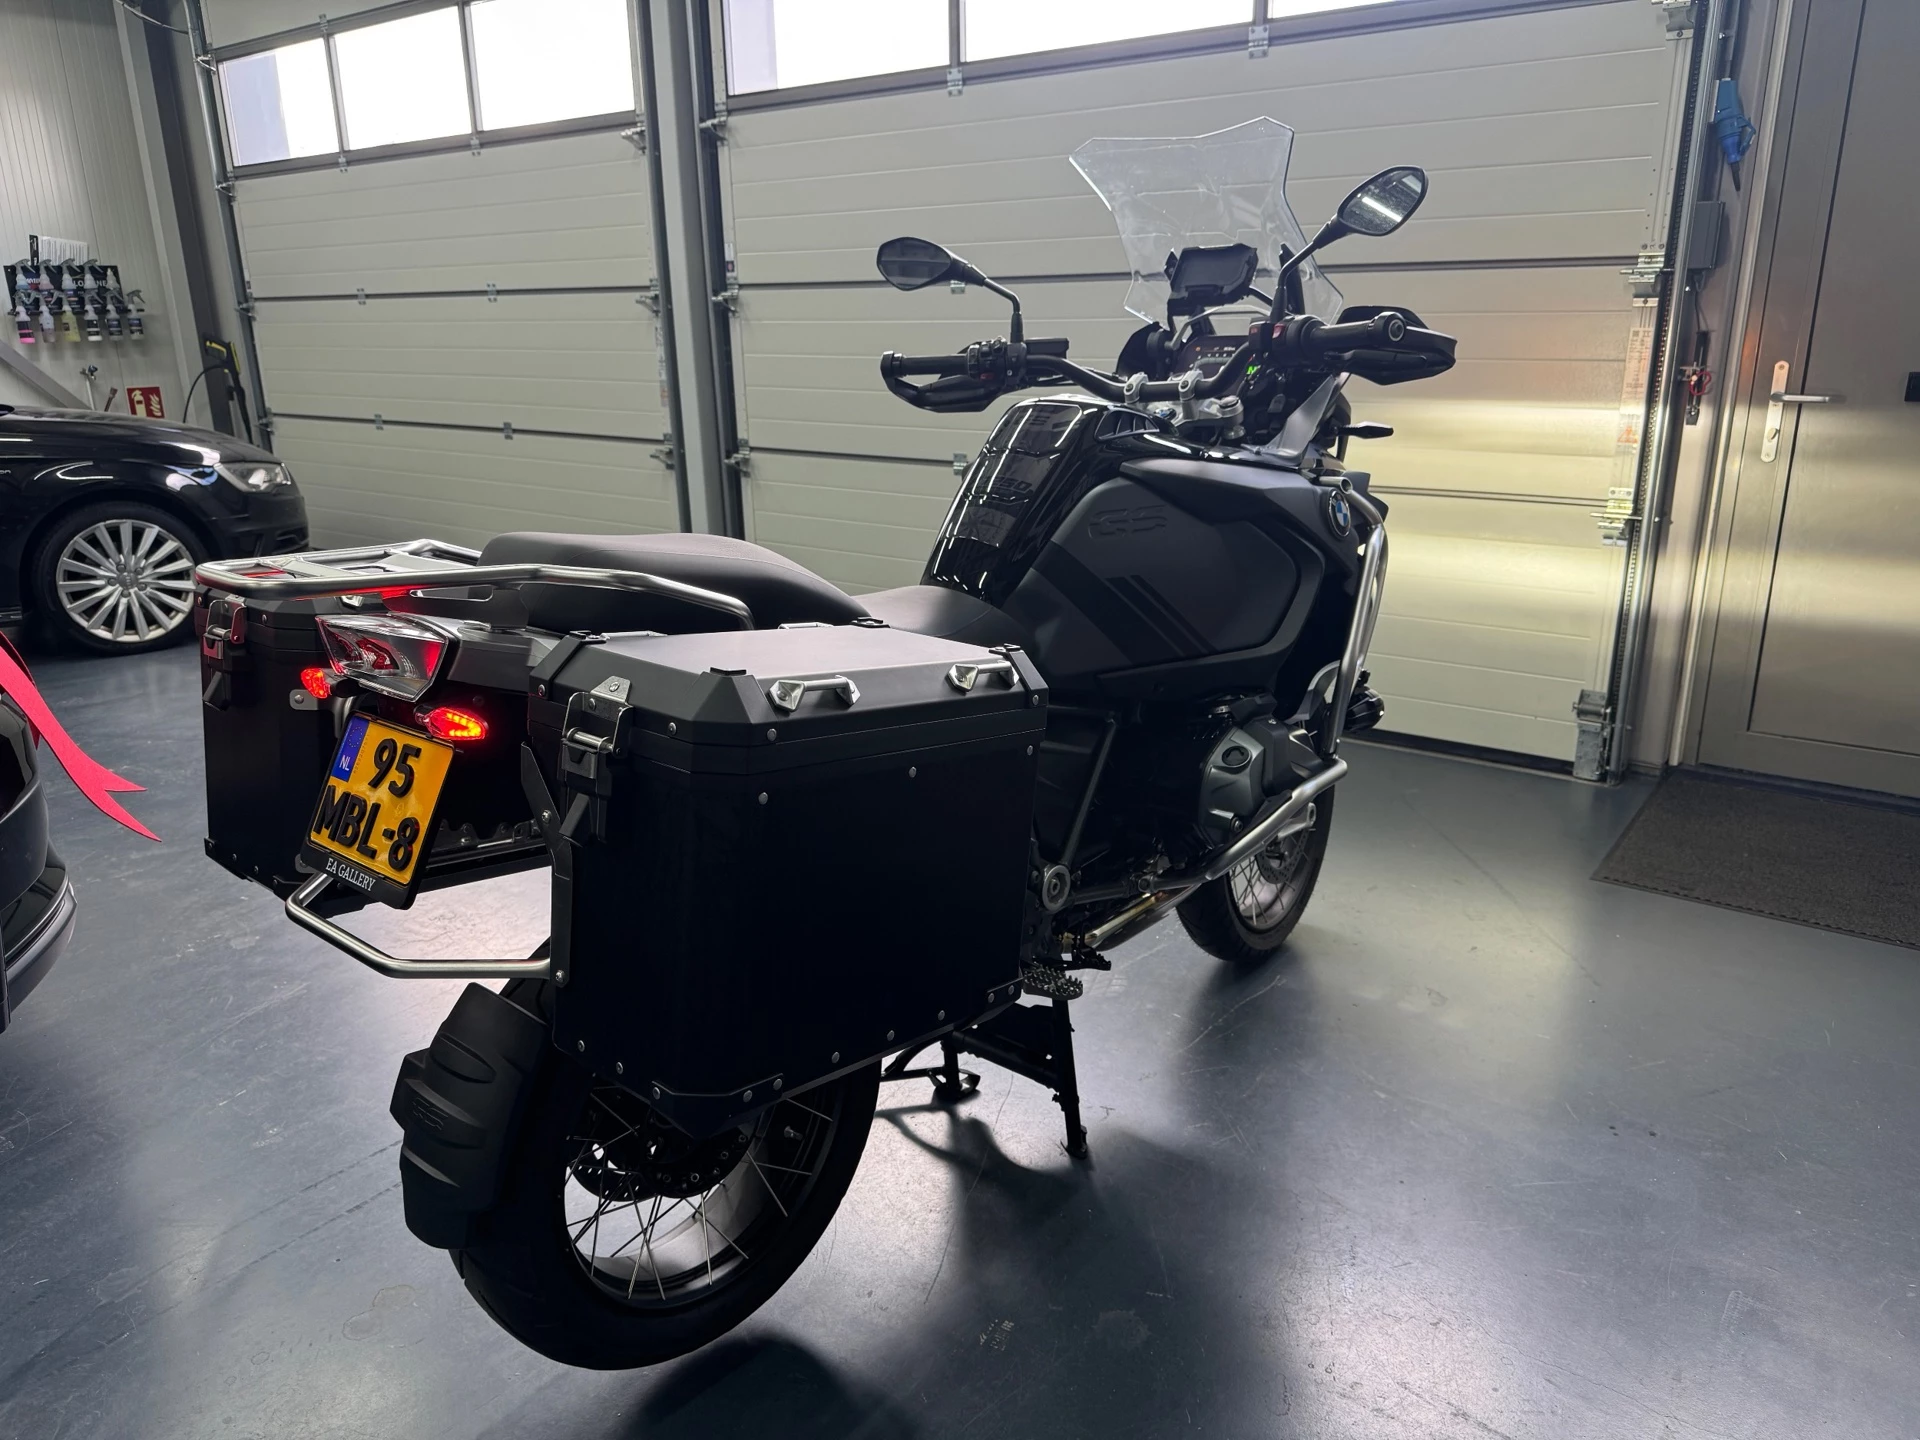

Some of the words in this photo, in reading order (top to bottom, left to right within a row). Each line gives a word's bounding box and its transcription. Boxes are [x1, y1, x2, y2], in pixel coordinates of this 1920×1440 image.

[1088, 505, 1168, 539] GS
[339, 754, 351, 771] NL
[368, 738, 422, 798] 95
[313, 785, 421, 872] MBL-8
[325, 857, 338, 874] EA
[338, 864, 376, 891] GALLERY
